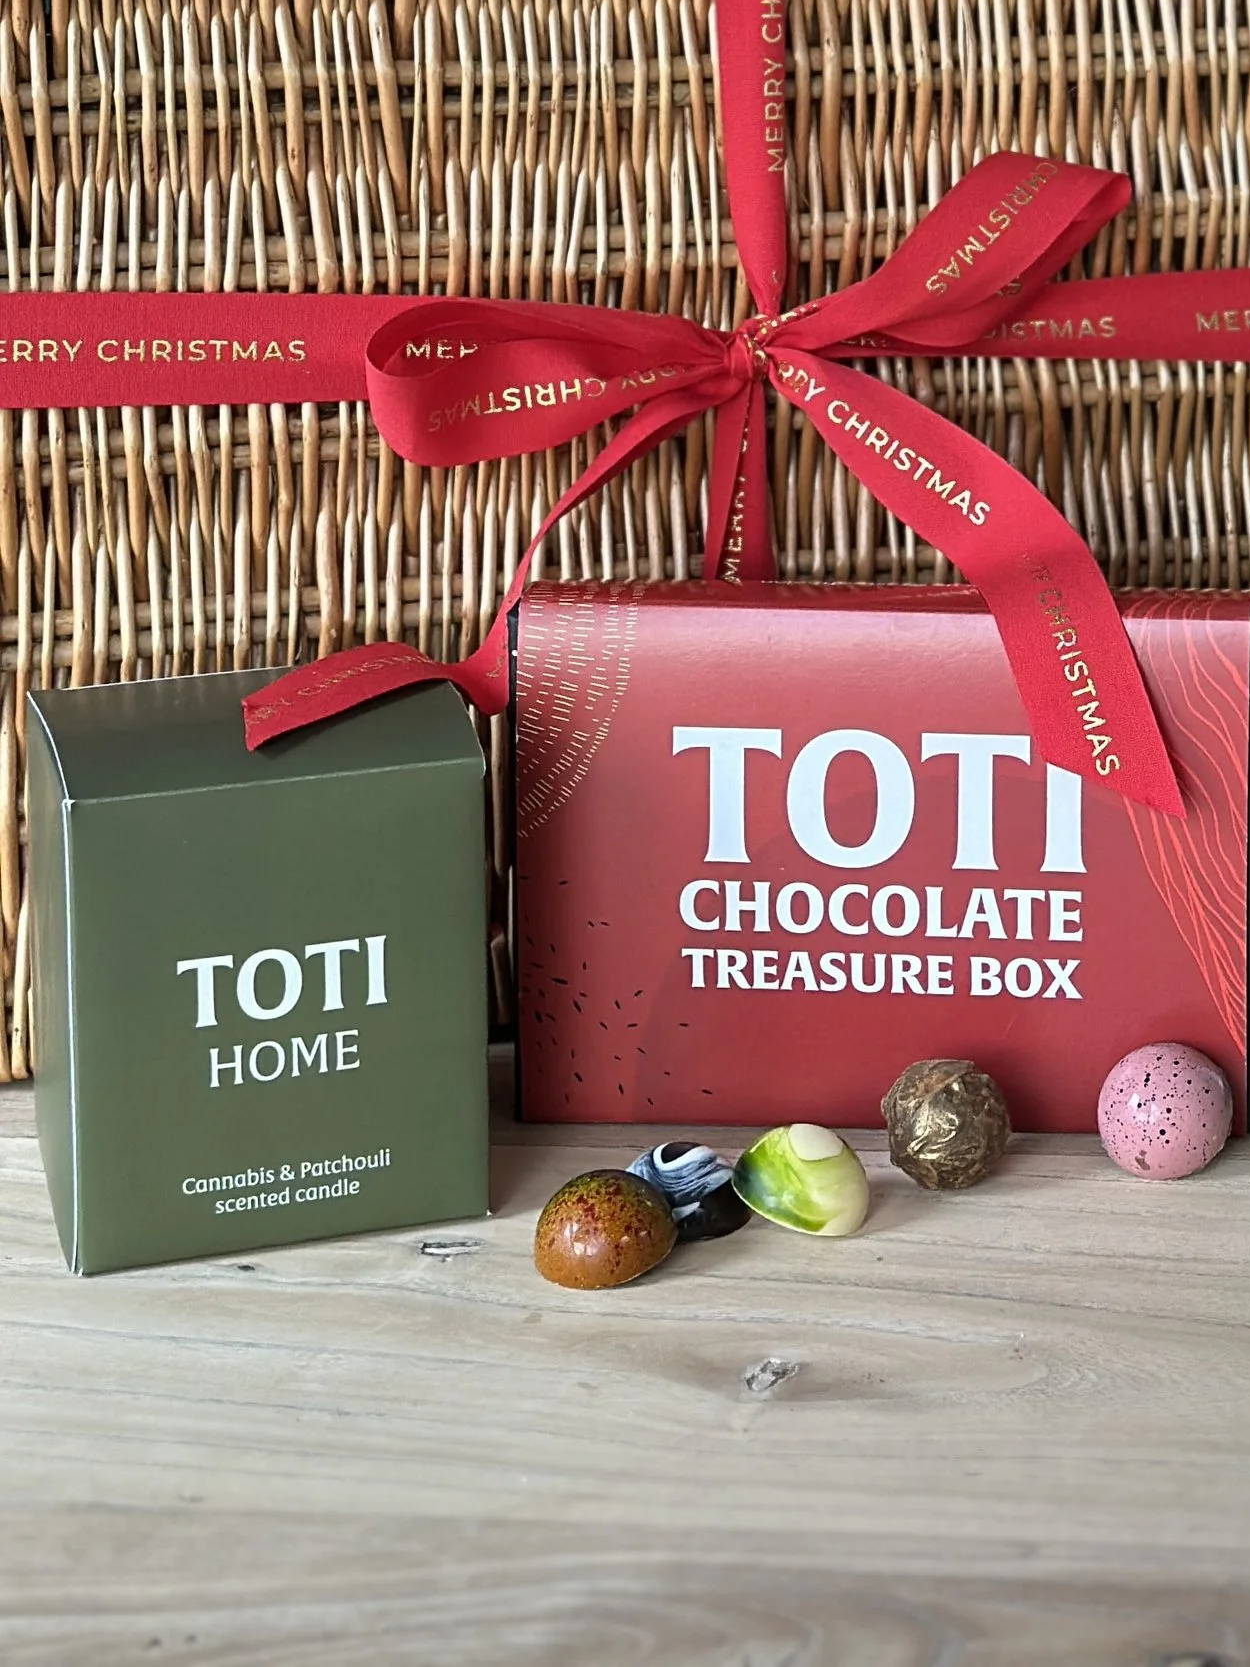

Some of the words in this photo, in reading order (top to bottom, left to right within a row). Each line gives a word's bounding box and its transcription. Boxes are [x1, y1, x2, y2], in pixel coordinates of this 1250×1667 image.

[762, 58, 785, 173] MERRY
[926, 161, 1058, 296] CHRISTMAS
[97, 339, 307, 362] CHRISTMAS
[983, 316, 1117, 341] ISTMAS
[428, 378, 608, 433] CHRISTMAS
[826, 399, 991, 526] CHRISTMAS
[1038, 588, 1120, 776] CHRISTMAS
[672, 725, 1088, 874] TOTI
[678, 879, 1084, 943] CHOCOLATE
[176, 934, 388, 1029] TOTI
[681, 947, 954, 996] TREASURE
[969, 956, 1083, 1000] BOX
[209, 1029, 360, 1088] HOME
[182, 1166, 275, 1195] Cannabis
[279, 1164, 296, 1181] &
[300, 1148, 391, 1179] Patchouli
[215, 1186, 290, 1214] scented
[295, 1178, 361, 1203] candle
